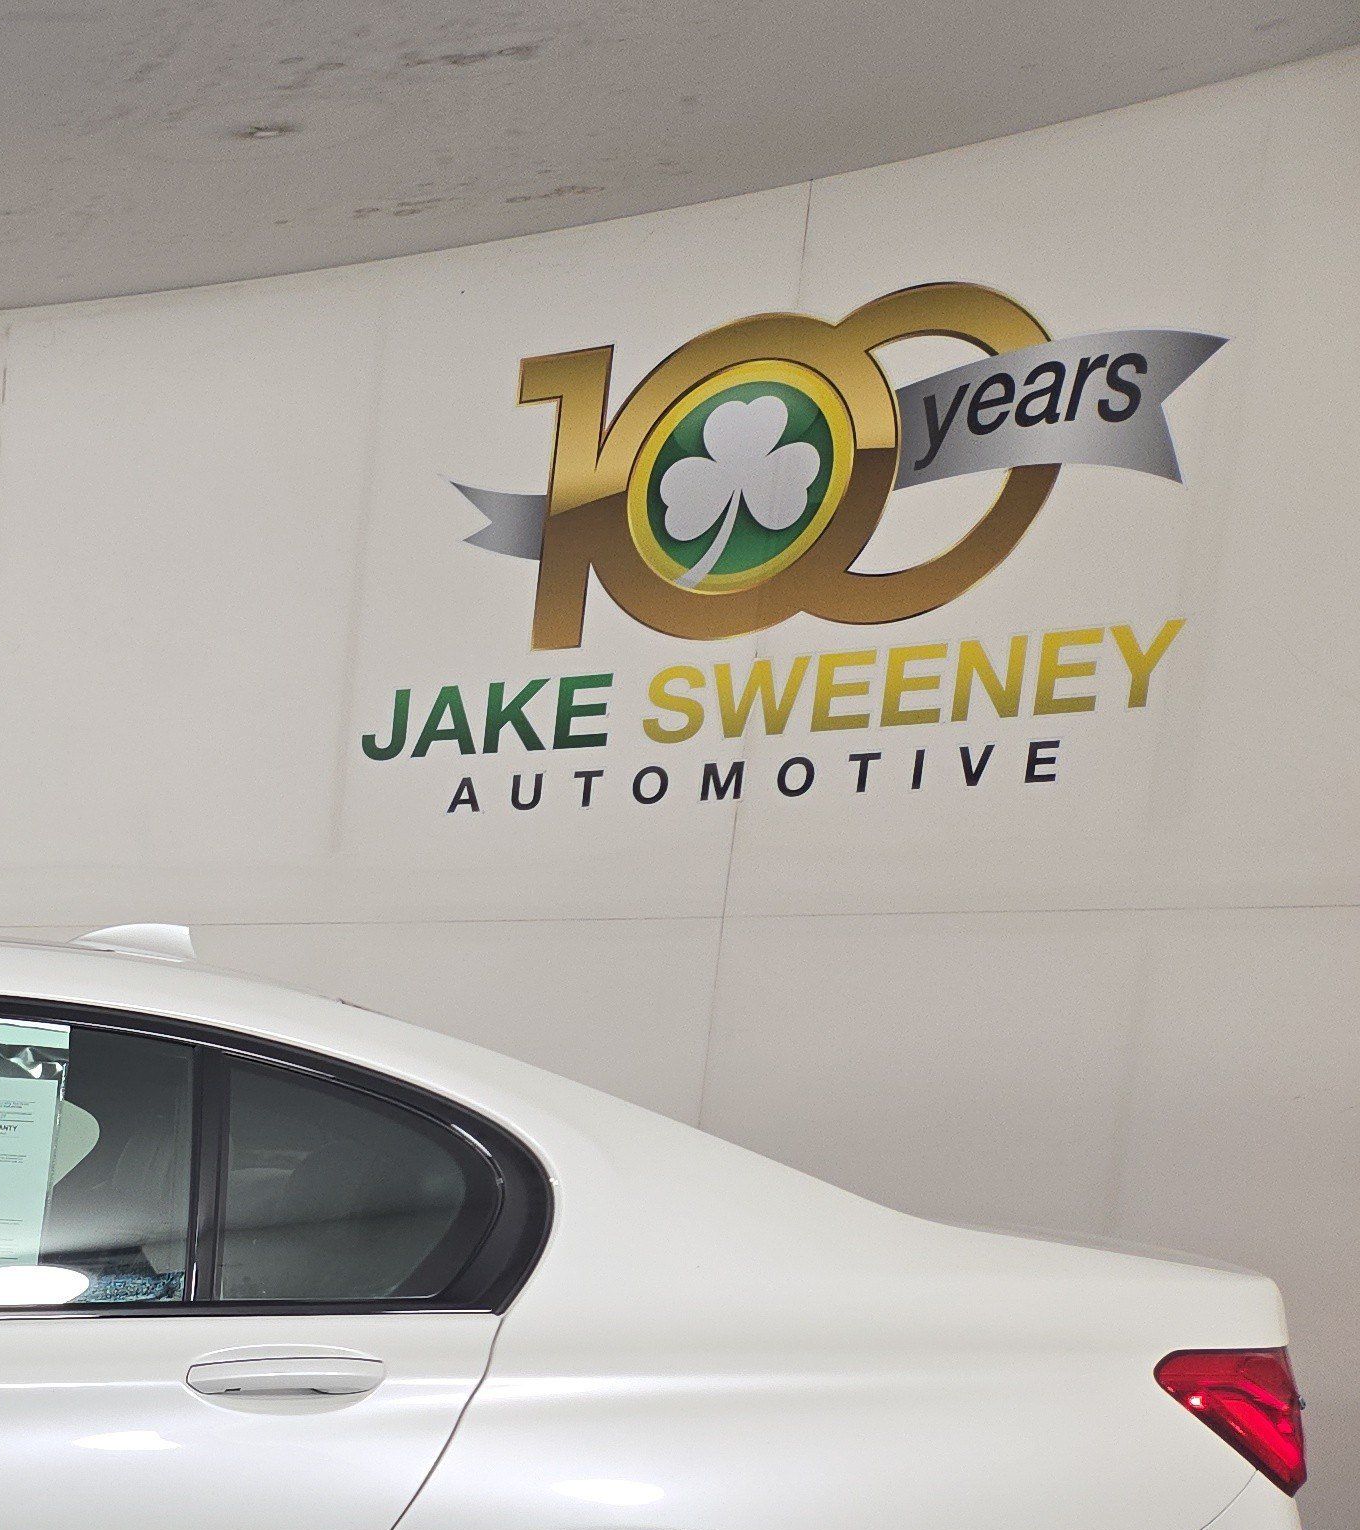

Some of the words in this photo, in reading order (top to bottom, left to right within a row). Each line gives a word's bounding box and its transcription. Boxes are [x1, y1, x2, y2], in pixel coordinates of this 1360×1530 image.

[913, 350, 1148, 469] years
[362, 672, 615, 762] JAKE
[643, 619, 1187, 745] SWEENEY
[446, 739, 1061, 815] AUTOMOTIVE
